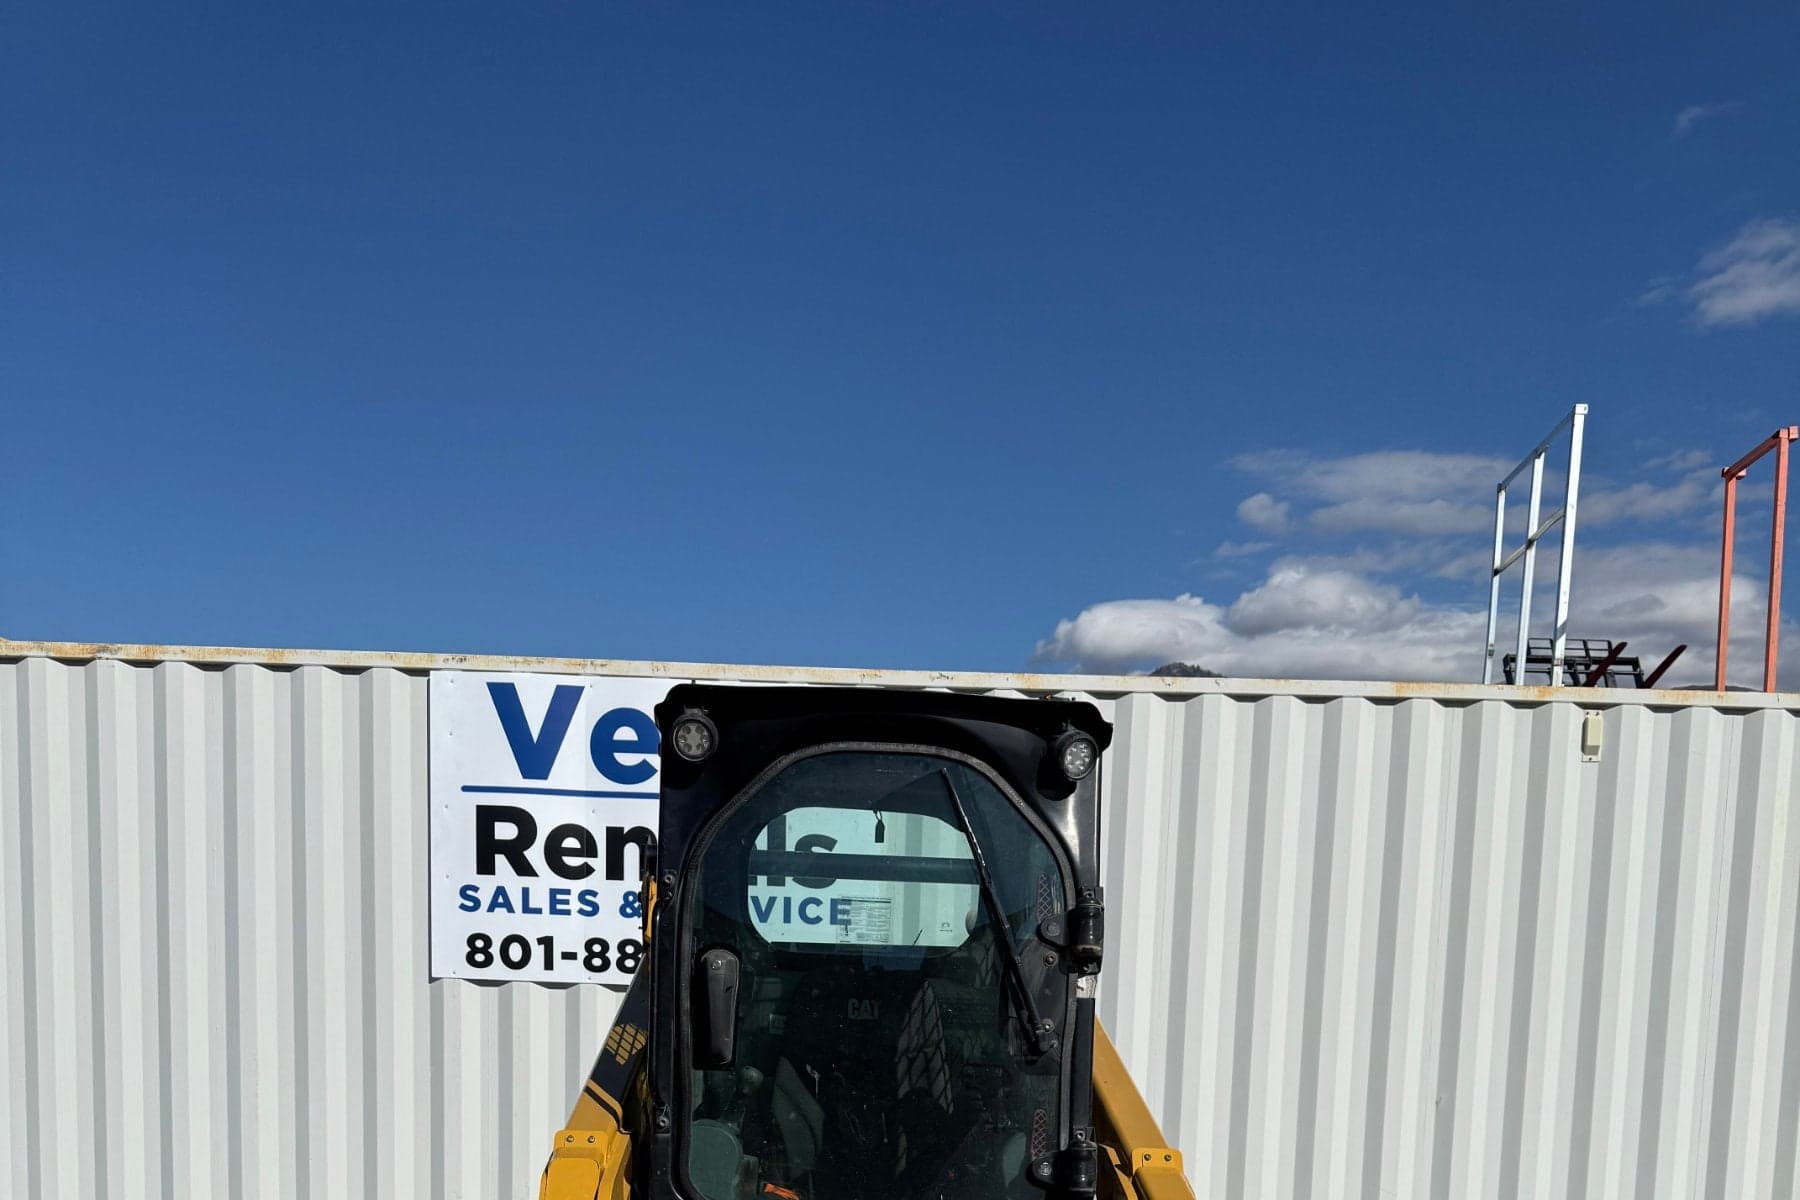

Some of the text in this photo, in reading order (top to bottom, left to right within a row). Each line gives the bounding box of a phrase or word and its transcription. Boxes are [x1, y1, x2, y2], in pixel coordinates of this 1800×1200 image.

[486, 682, 661, 785] Ve
[458, 884, 600, 917] SALES
[750, 895, 852, 926] VICE
[465, 932, 642, 974] 801-88
